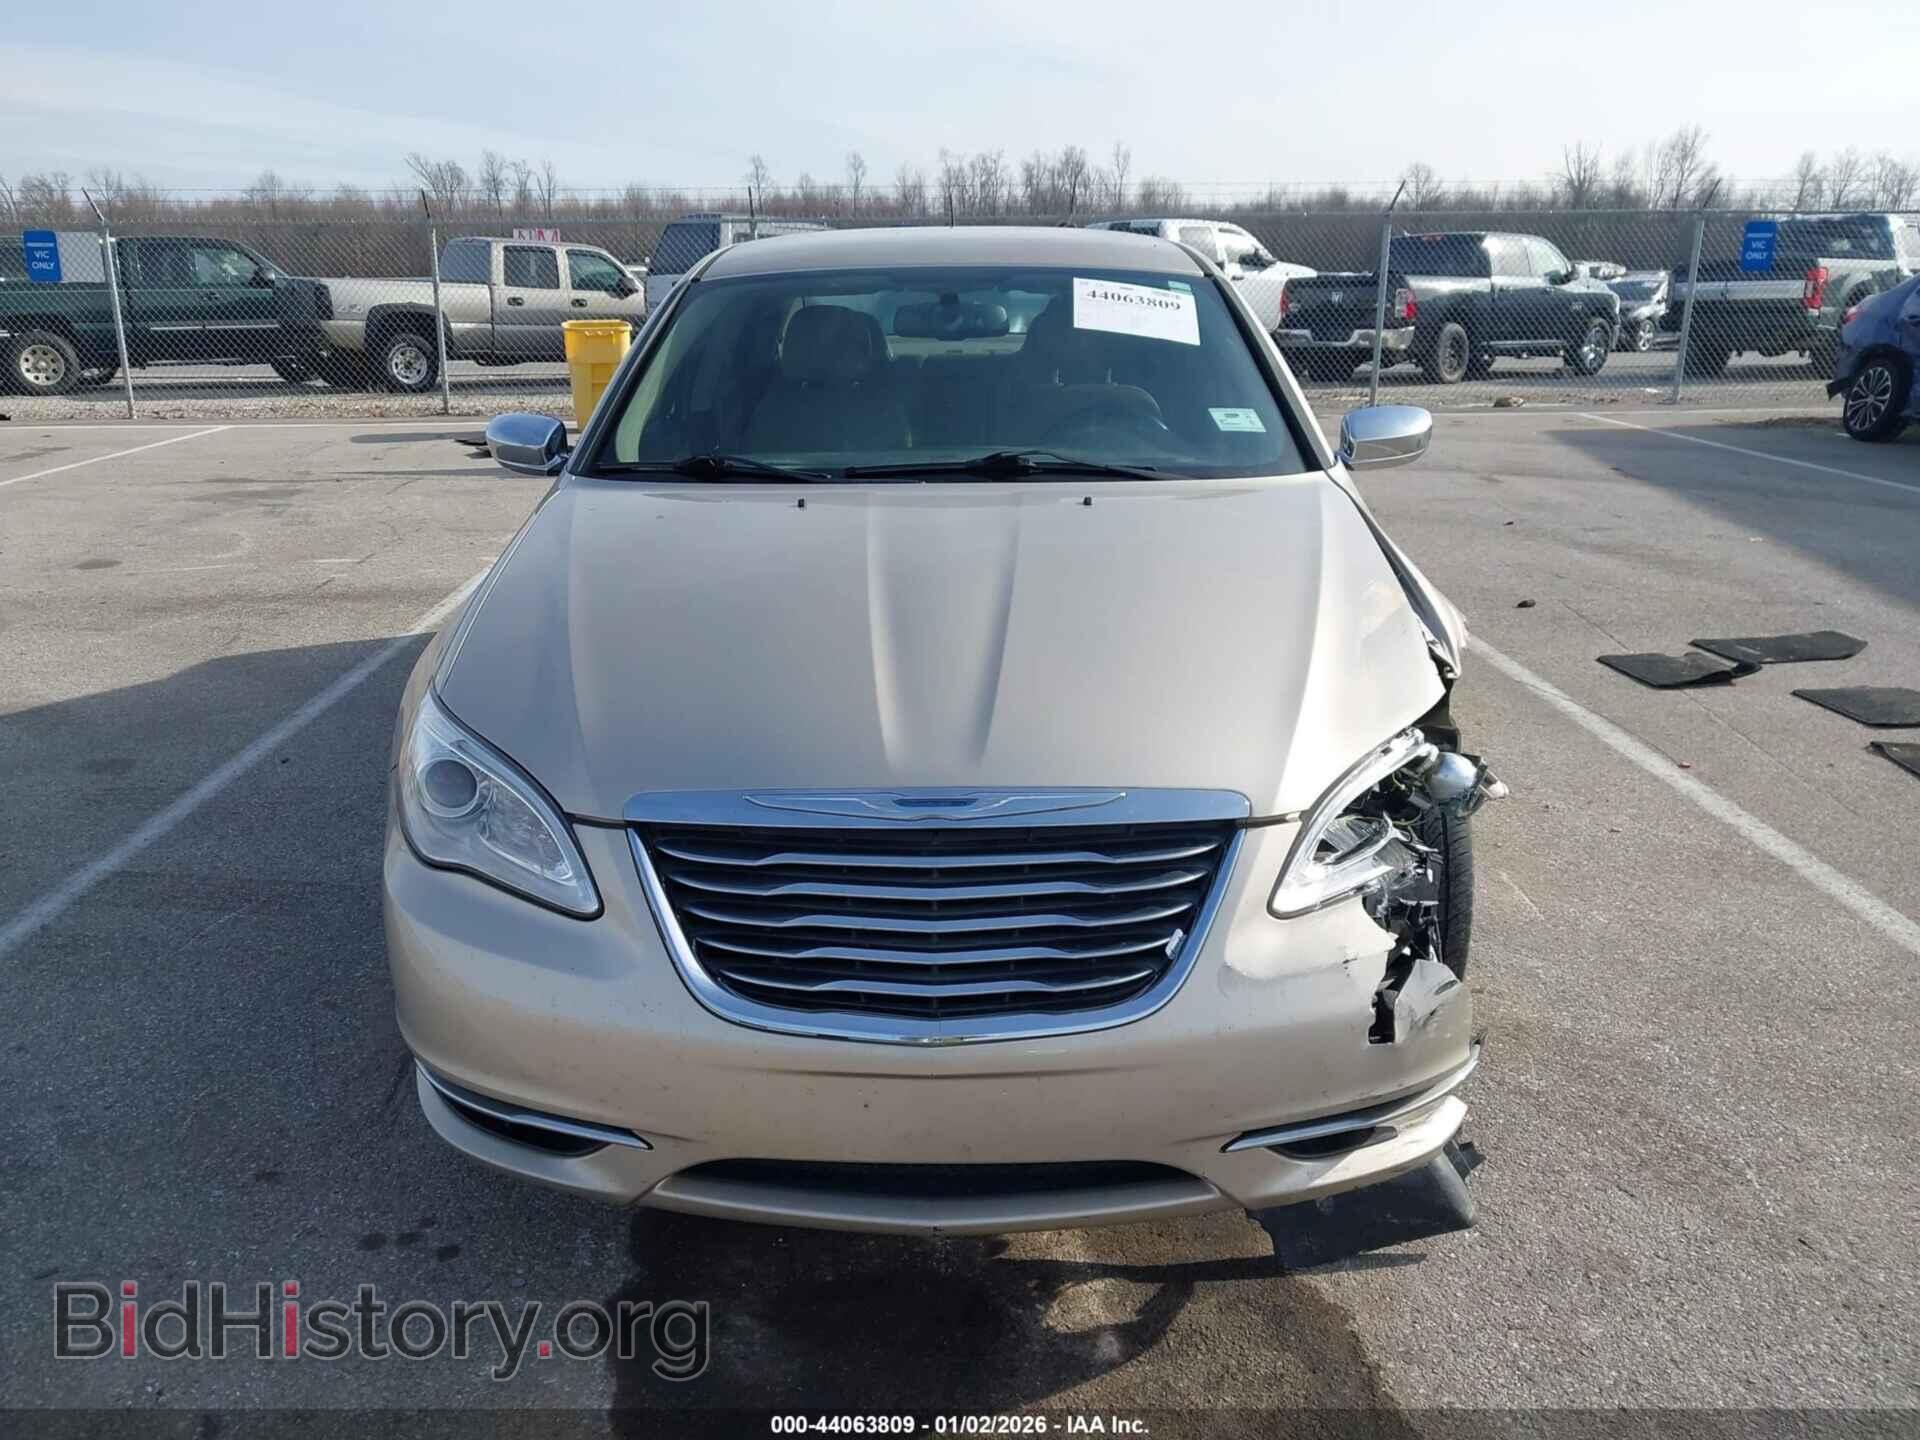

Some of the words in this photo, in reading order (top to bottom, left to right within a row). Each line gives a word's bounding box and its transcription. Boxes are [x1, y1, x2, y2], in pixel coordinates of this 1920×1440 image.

[33, 250, 50, 259] VIC
[1745, 250, 1768, 260] ONLY
[31, 261, 55, 270] ONLY
[1087, 289, 1181, 310] 44063809
